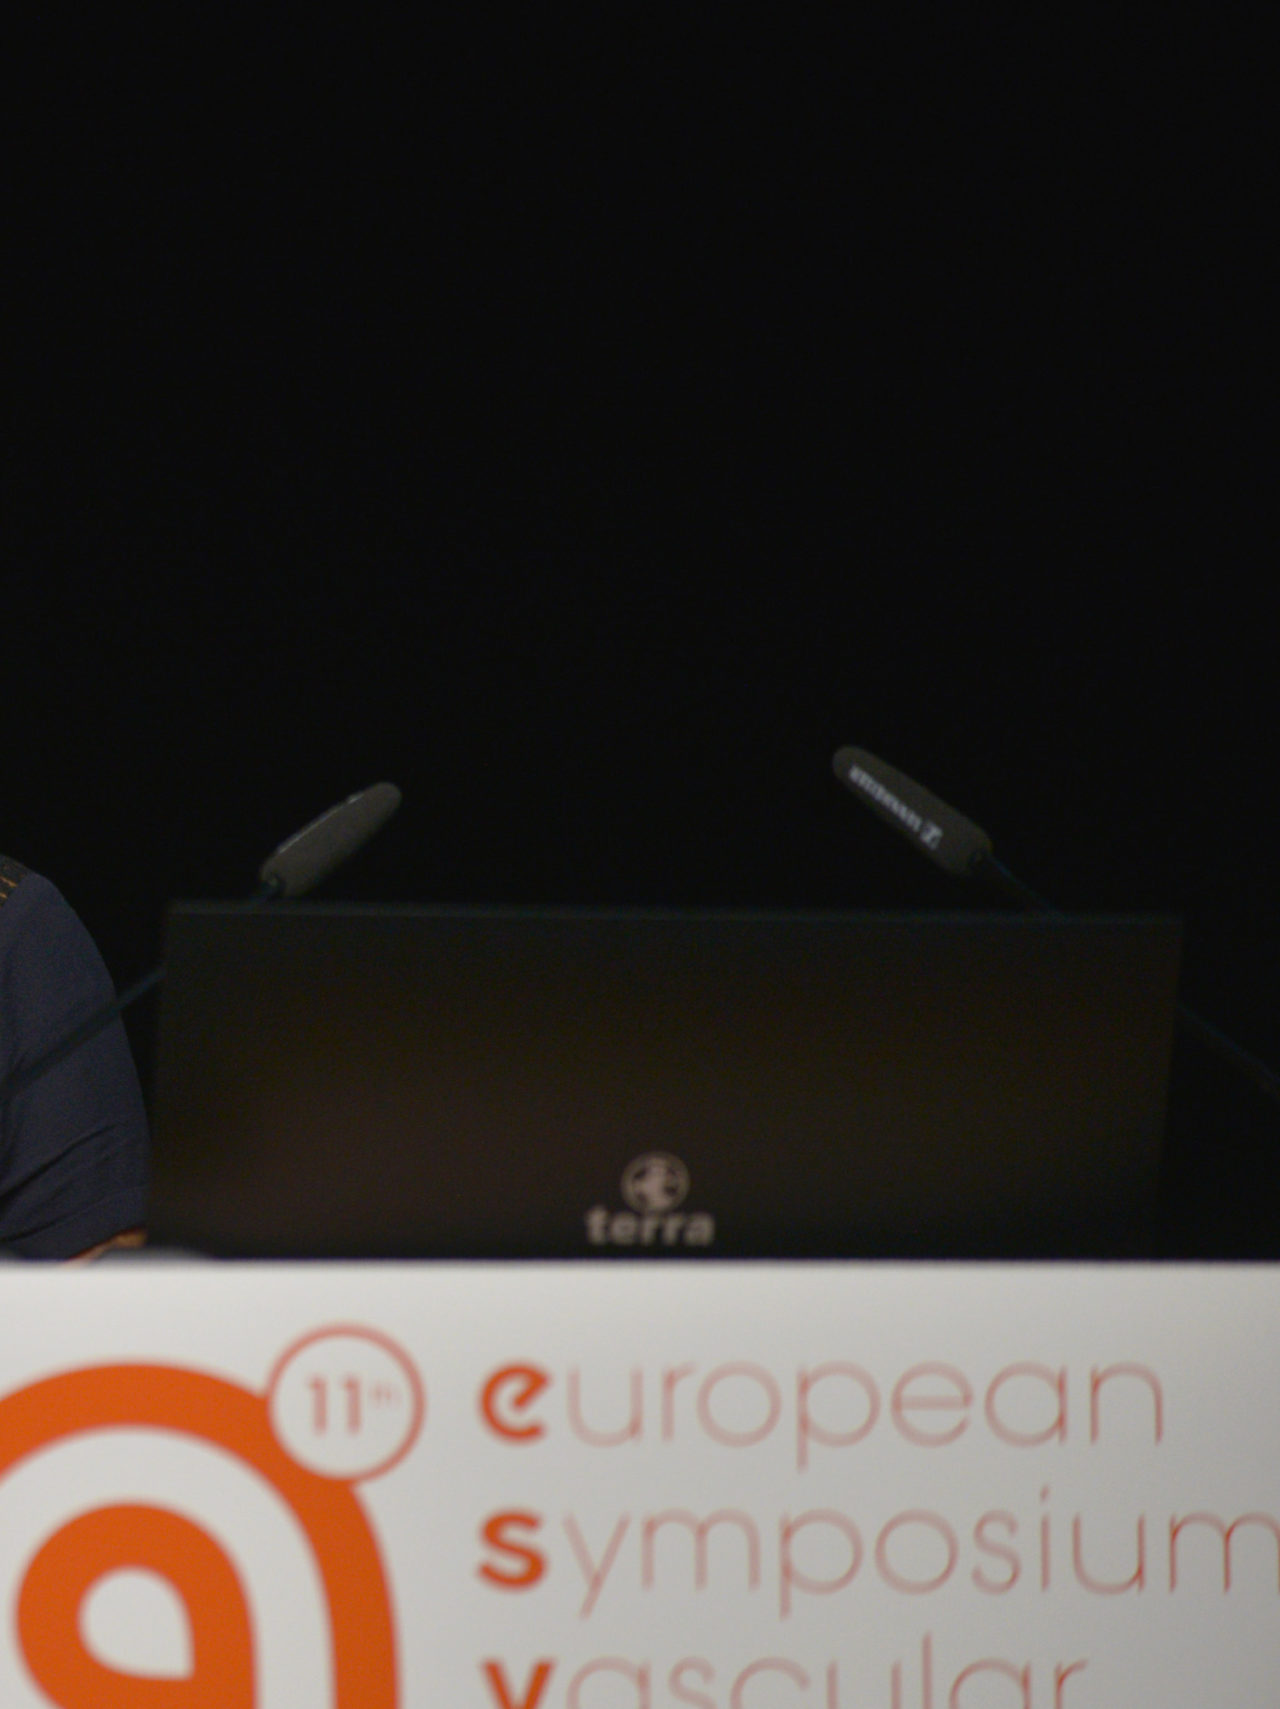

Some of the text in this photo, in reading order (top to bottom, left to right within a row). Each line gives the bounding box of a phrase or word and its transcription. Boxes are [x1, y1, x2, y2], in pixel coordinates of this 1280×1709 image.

[586, 1206, 715, 1245] terra
[477, 1359, 1165, 1471] european
[476, 1485, 1280, 1619] symposium
